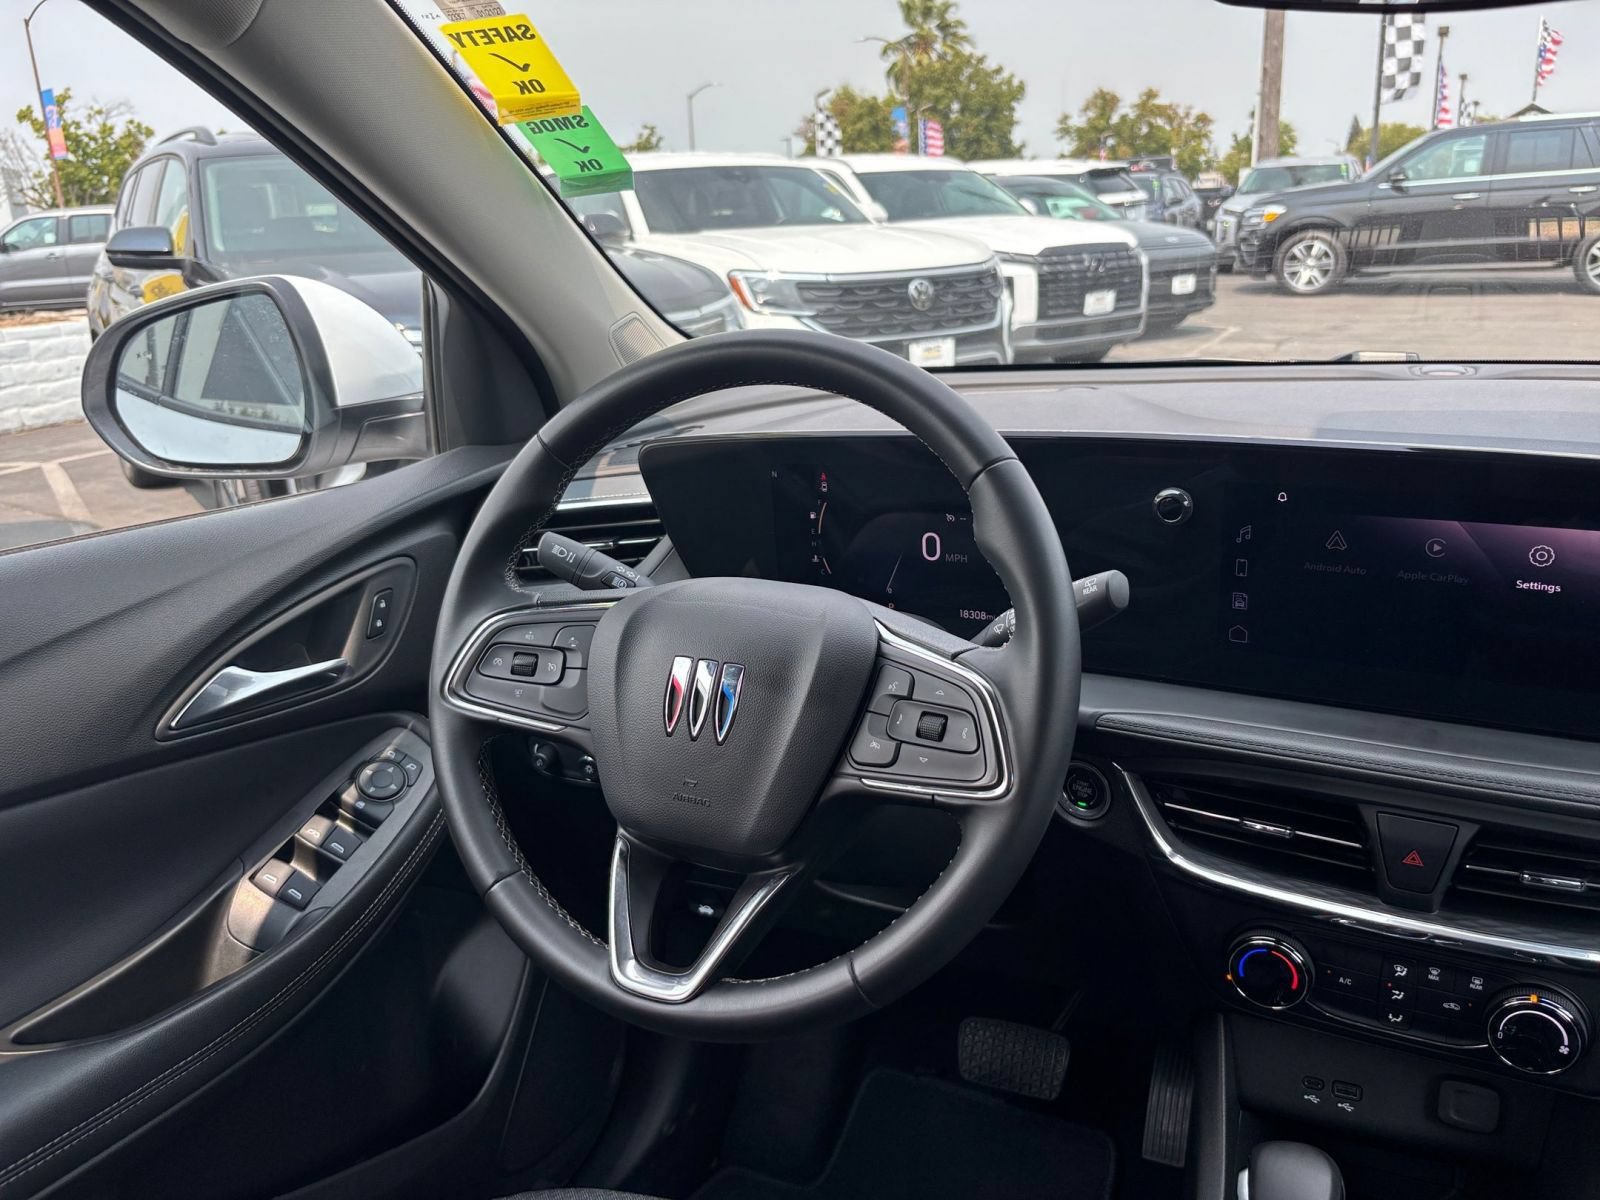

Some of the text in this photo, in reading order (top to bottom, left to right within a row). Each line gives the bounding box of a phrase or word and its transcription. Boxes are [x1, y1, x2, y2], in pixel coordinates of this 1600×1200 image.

[921, 531, 941, 561] 0
[945, 553, 968, 564] MPH
[1303, 561, 1367, 576] Android Auto
[1396, 568, 1470, 586] Apple CarPlay
[1082, 584, 1098, 596] REAR
[1515, 579, 1562, 593] Settings
[672, 792, 711, 807] AIRBAG
[1338, 976, 1352, 986] A/C
[1428, 973, 1439, 981] MAX
[1470, 982, 1482, 991] REAR
